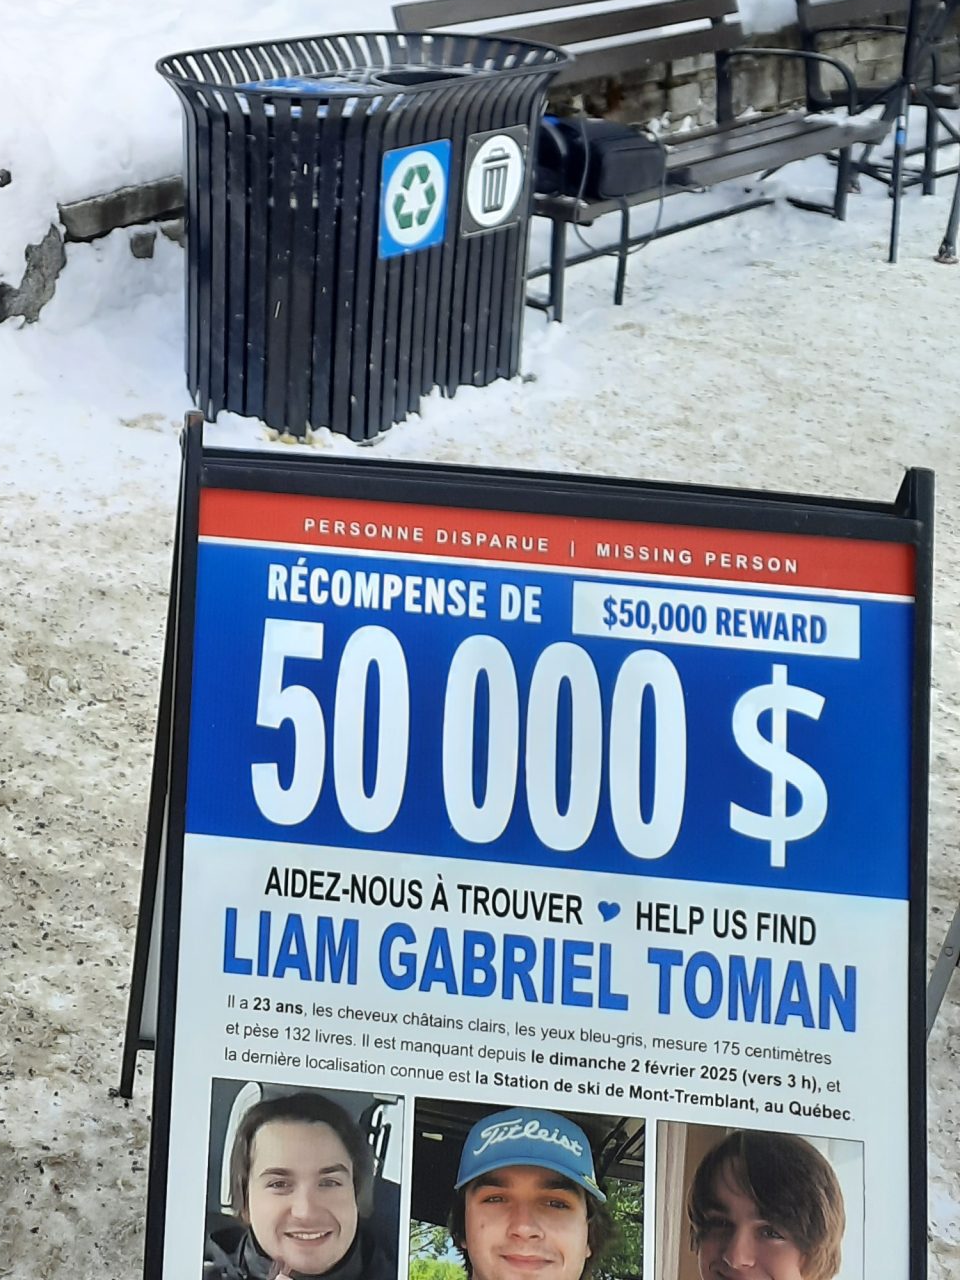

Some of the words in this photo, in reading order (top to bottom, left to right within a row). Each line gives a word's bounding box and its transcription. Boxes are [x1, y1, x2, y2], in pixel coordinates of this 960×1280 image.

[305, 519, 423, 542] PERSONNE
[437, 530, 548, 552] DISPARUE
[597, 543, 691, 564] MISSING
[705, 552, 796, 573] PERSON
[268, 558, 487, 618] RÉCOMPENSE
[501, 584, 541, 622] DE
[604, 597, 707, 634] $50,000
[716, 608, 827, 645] REWARD
[252, 619, 409, 832] 50
[443, 635, 686, 858] 000
[731, 664, 827, 867] $
[264, 866, 423, 910] AIDEZ-NOUS
[430, 873, 449, 912] À
[457, 884, 583, 925] TROUVER
[636, 901, 704, 935] HELP
[713, 908, 747, 940] US
[757, 912, 816, 946] FIND
[223, 908, 359, 986] LIAM
[379, 923, 629, 1012] GABRIEL
[647, 948, 858, 1033] TOMAN
[226, 1022, 240, 1035] et
[244, 1023, 279, 1039] pèse
[285, 1026, 311, 1042] 132
[315, 1028, 356, 1046] livres.
[362, 1033, 369, 1047] Il
[374, 1037, 396, 1050] est
[400, 1040, 474, 1058] manquant
[478, 1045, 526, 1063] depuis
[531, 1049, 544, 1064] le
[549, 1052, 626, 1071] dimanche
[631, 1059, 640, 1072] 2
[644, 1060, 696, 1078] février
[700, 1065, 737, 1082] 2025
[742, 1069, 782, 1087] (vers
[787, 1074, 796, 1088] 3
[801, 1075, 821, 1094] h),
[826, 1080, 841, 1093] et
[228, 994, 235, 1008] Il
[240, 999, 248, 1009] a
[253, 997, 270, 1011] 23
[276, 1002, 307, 1017] ans,
[313, 1002, 333, 1017] les
[338, 1005, 398, 1024] cheveux
[403, 1012, 463, 1030] châtains
[468, 1018, 509, 1036] clairs,
[515, 1021, 536, 1037] les
[541, 1027, 575, 1041] yeux
[580, 1028, 647, 1049] bleu-gris,
[652, 1038, 708, 1053] mesure
[713, 1040, 740, 1056] 175
[745, 1046, 832, 1065] centimètres
[225, 1046, 237, 1061] la
[241, 1049, 301, 1067] dernière
[306, 1054, 385, 1075] localisation
[390, 1066, 444, 1081] connue
[449, 1070, 471, 1083] est
[475, 1070, 488, 1085] la
[493, 1072, 548, 1091] Station
[554, 1078, 573, 1093] de
[577, 1081, 600, 1095] ski
[605, 1083, 624, 1097] de
[629, 1085, 759, 1113] Mont-Tremblant,
[764, 1101, 784, 1113] au
[473, 1118, 584, 1157] Titleist
